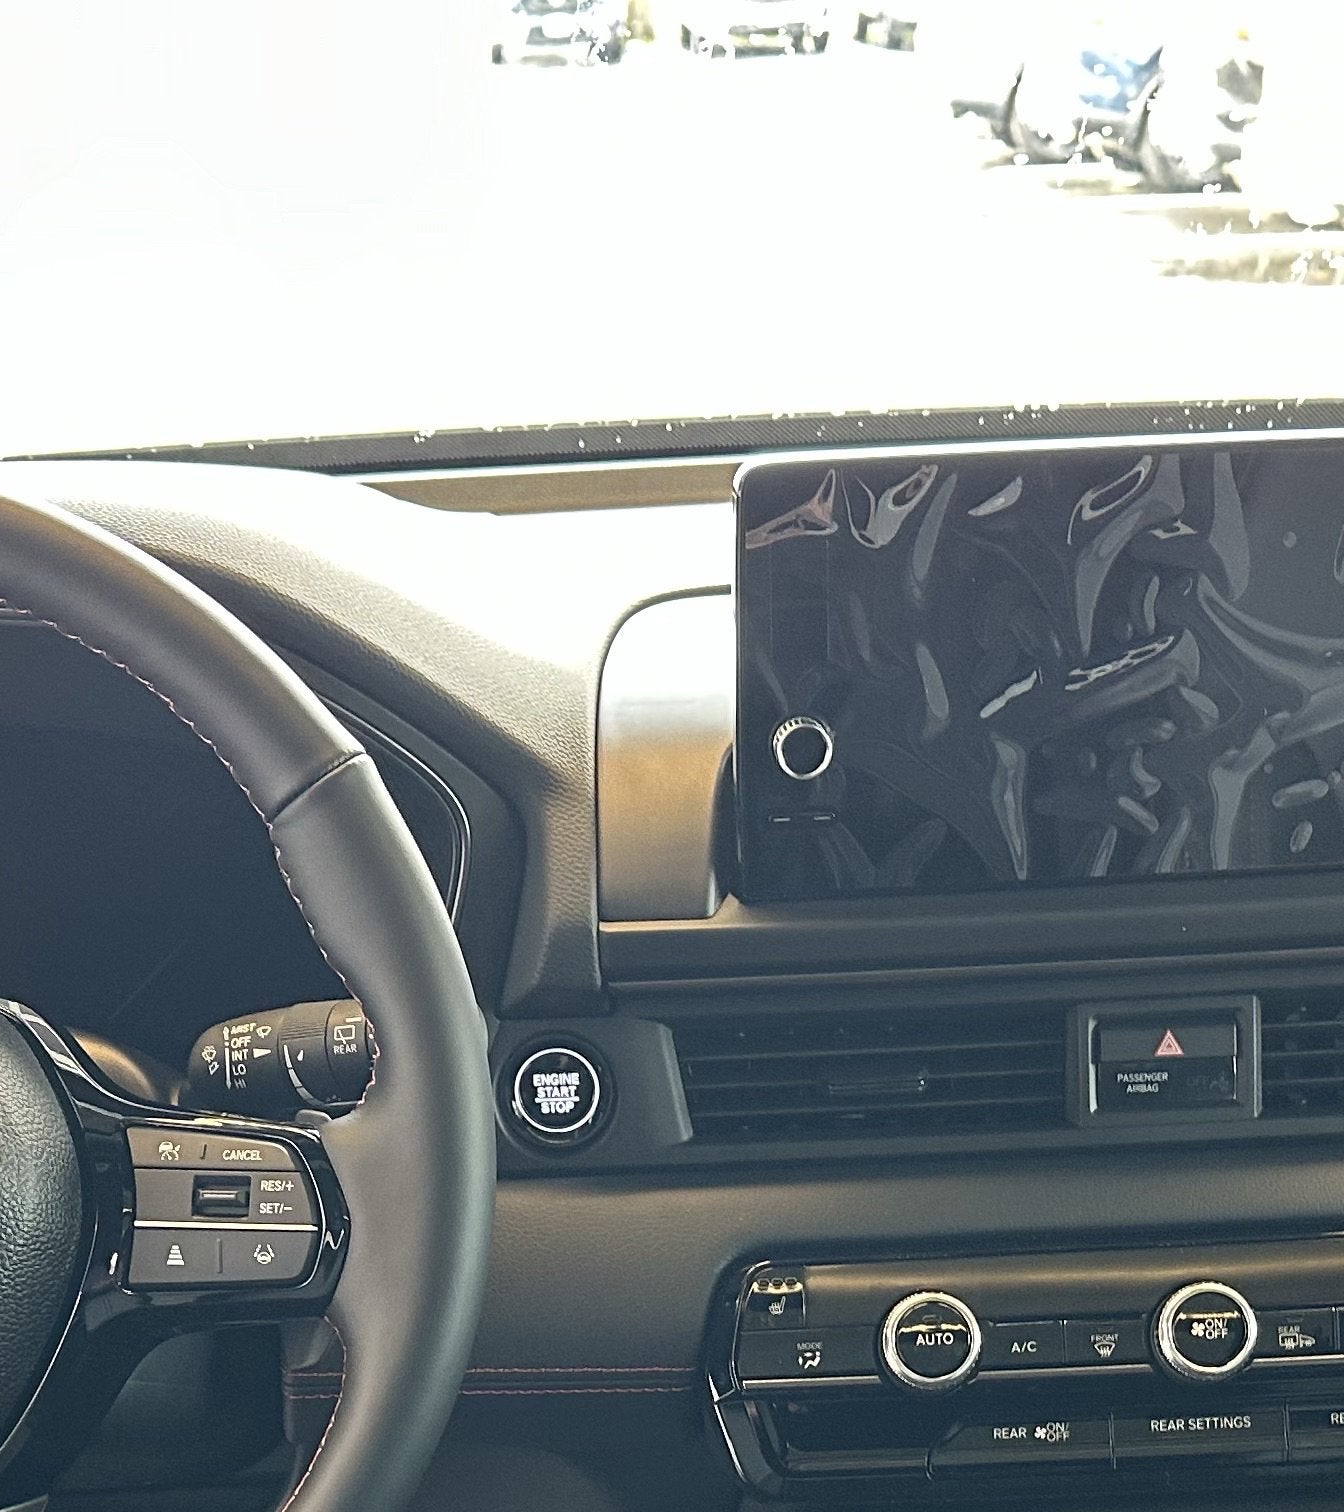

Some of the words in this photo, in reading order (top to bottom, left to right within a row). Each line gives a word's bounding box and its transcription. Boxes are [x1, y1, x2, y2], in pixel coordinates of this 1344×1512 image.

[230, 1036, 252, 1049] OFF
[333, 1043, 358, 1055] REAR
[231, 1049, 249, 1061] INT
[232, 1063, 247, 1076] LO
[532, 1072, 580, 1087] ENGINE
[1116, 1071, 1169, 1082] PASSENGER
[234, 1078, 247, 1089] HI
[537, 1086, 577, 1098] START
[540, 1101, 575, 1114] STOP
[222, 1148, 263, 1162] CANCEL
[915, 1331, 955, 1347] AUTO
[1090, 1332, 1120, 1344] FRONT
[1205, 1328, 1229, 1340] OFF
[1010, 1340, 1038, 1354] A/C
[1150, 1418, 1184, 1432] REAR
[1188, 1415, 1252, 1430] SETTINGS
[993, 1426, 1028, 1440] REAR
[1046, 1431, 1071, 1443] OFF
